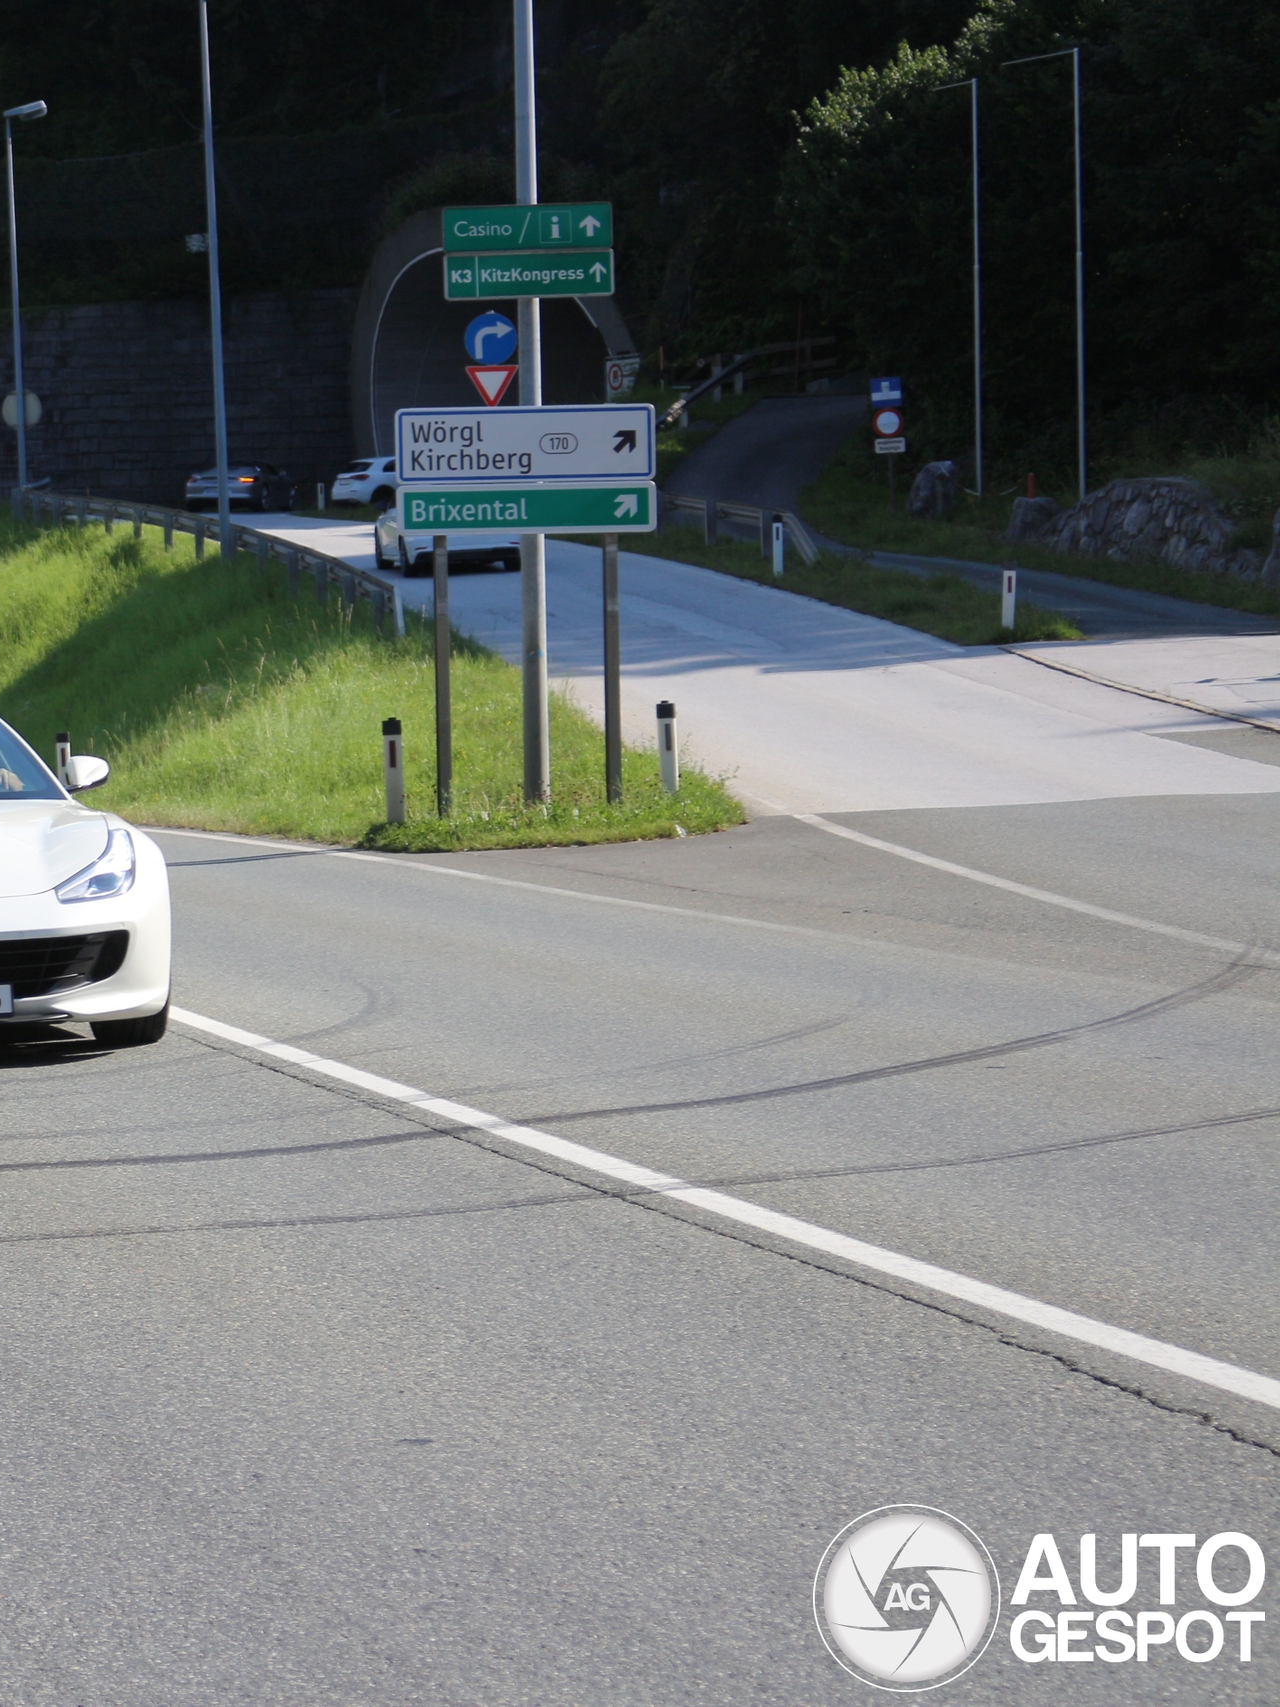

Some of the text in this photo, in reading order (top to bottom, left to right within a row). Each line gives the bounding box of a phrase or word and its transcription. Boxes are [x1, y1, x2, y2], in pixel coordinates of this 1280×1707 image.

[454, 221, 512, 237] Casino
[451, 267, 584, 284] K3 KitzKongress
[411, 421, 483, 447] Wörgl
[549, 438, 568, 450] 170
[412, 450, 532, 474] Kirchberg
[412, 499, 528, 522] Brixental
